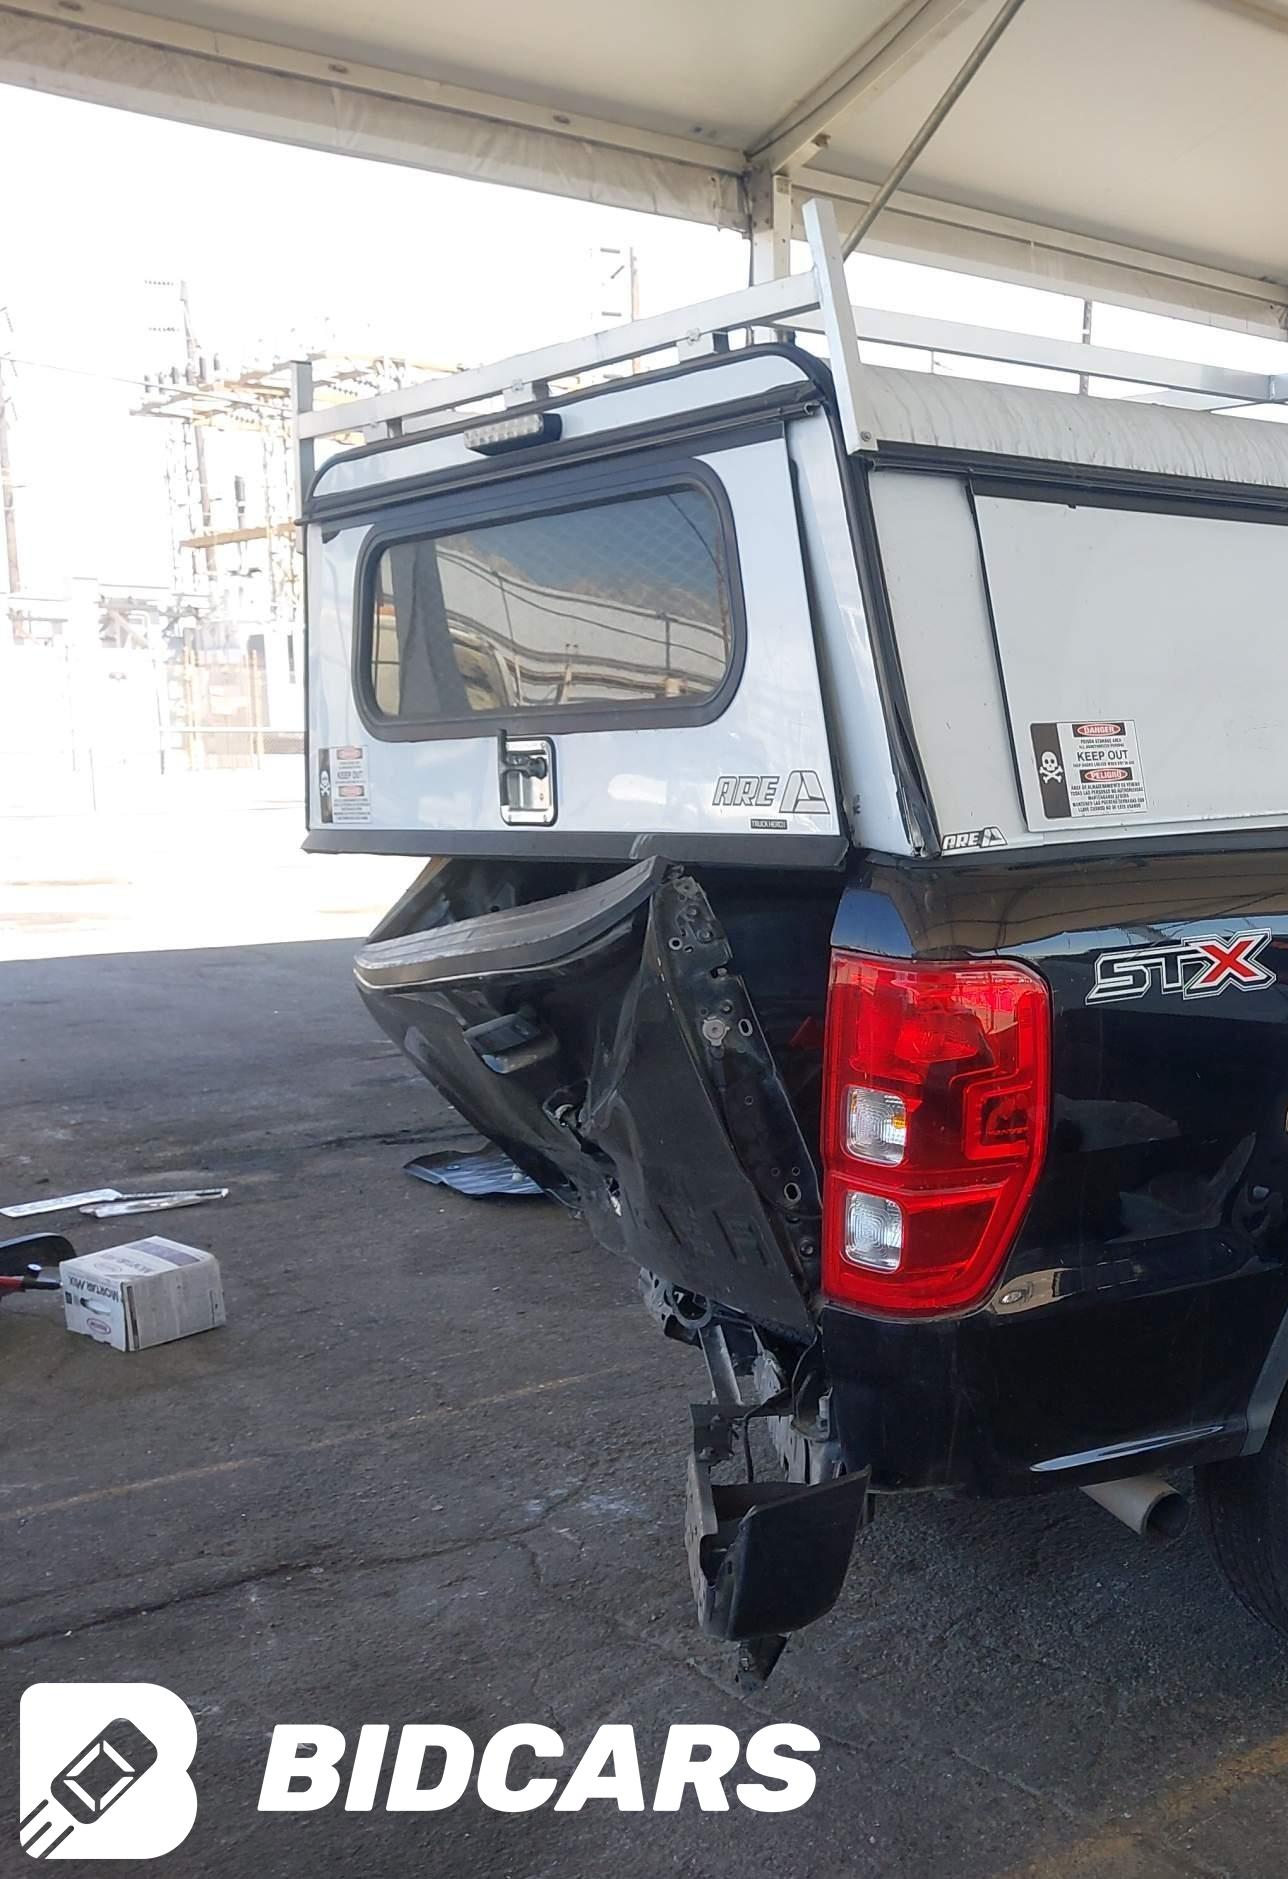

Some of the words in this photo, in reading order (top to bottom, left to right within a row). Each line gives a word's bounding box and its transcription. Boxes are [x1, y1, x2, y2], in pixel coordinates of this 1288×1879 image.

[1077, 751, 1105, 761] KEEP
[1107, 750, 1129, 760] OUT
[712, 775, 780, 806] ARE
[942, 831, 981, 850] ARE
[1085, 928, 1277, 1005] STX
